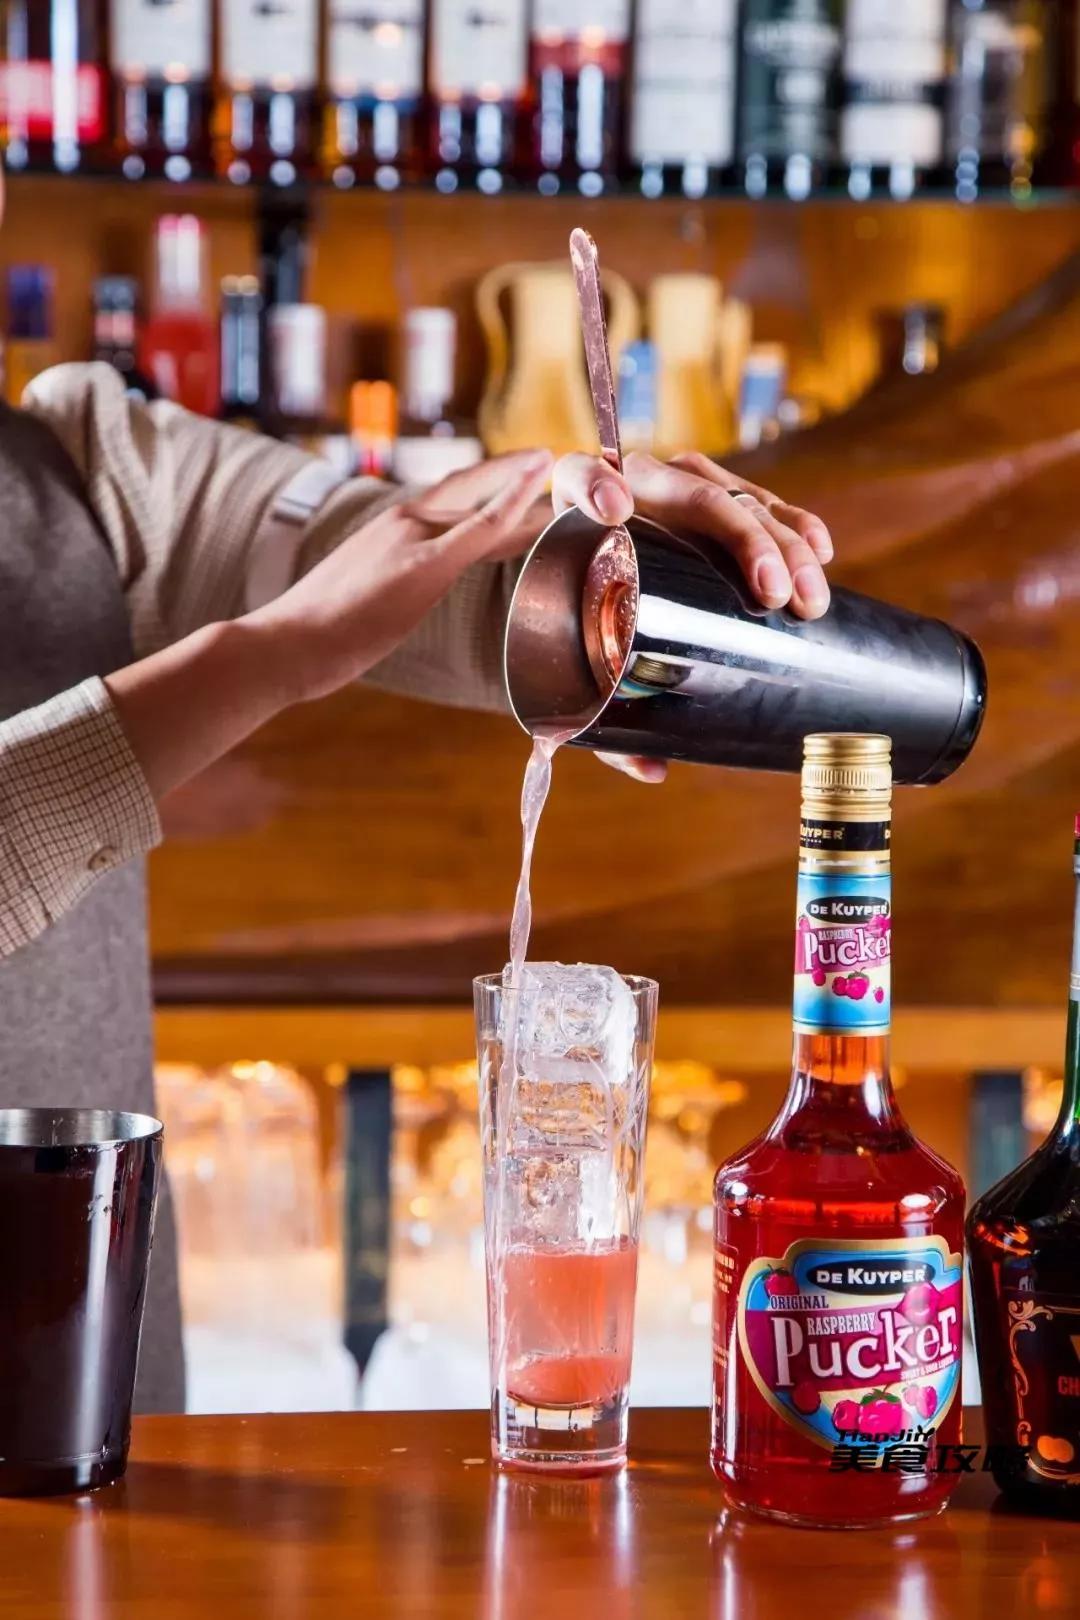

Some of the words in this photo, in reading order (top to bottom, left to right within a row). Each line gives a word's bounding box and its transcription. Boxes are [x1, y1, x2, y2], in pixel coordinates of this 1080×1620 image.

[811, 903, 828, 915] DE
[832, 902, 887, 917] KUYPER
[816, 1269, 842, 1284] DE
[848, 1267, 926, 1285] KUYPER
[770, 1294, 829, 1310] ORIGINAL
[807, 1311, 876, 1336] RASPBERRY
[770, 1306, 957, 1387] Pucker
